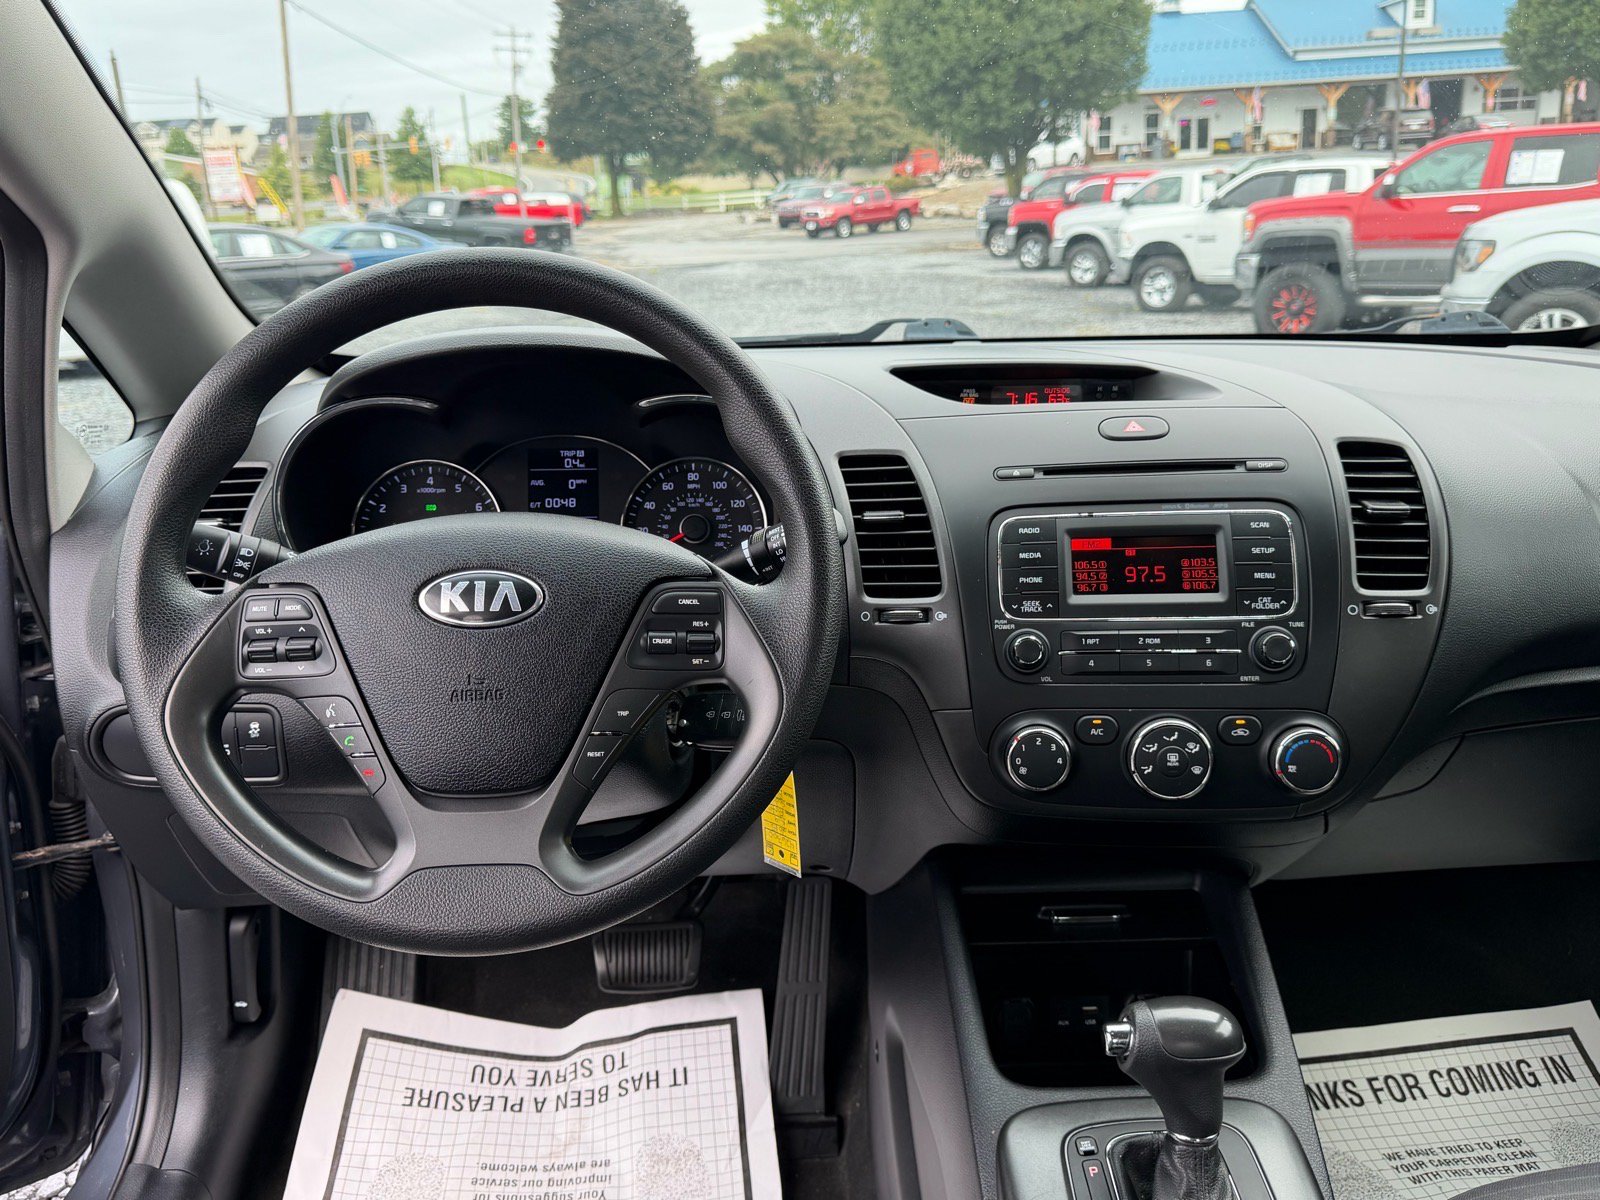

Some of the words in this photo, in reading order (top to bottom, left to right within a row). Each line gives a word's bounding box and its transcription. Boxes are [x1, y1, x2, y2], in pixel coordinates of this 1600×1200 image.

[1006, 392, 1038, 405] 7:16
[426, 476, 434, 485] 4
[687, 472, 700, 481] 80
[400, 484, 407, 494] 3
[455, 483, 462, 493] 5
[662, 482, 674, 491] 60
[712, 481, 728, 490] 100
[379, 504, 387, 513] 2
[475, 503, 483, 512] 6
[643, 501, 656, 510] 40
[730, 499, 745, 508] 120
[737, 524, 753, 533] 140
[770, 533, 780, 541] OFF
[775, 548, 784, 556] LO
[1074, 561, 1098, 569] 106.5
[1190, 558, 1215, 566] 103.5
[1075, 572, 1097, 580] 94.5
[1125, 565, 1166, 583] 97.5
[1191, 570, 1216, 578] 105.5
[1191, 581, 1216, 589] 106.7
[440, 580, 522, 613] KIA
[1206, 659, 1212, 667] 6
[450, 688, 504, 702] AIRBAG
[602, 1051, 629, 1074] TO
[471, 1064, 516, 1087] YOU
[525, 1058, 593, 1087] SERVE
[669, 1066, 688, 1088] IT
[618, 1070, 660, 1097] HAS
[1366, 1073, 1428, 1105] FOR
[1428, 1058, 1541, 1099] COMING
[1540, 1055, 1577, 1084] IN
[401, 1086, 524, 1113] PLEASURE
[555, 1085, 609, 1112] BEEN
[534, 1097, 547, 1113] A
[1383, 1151, 1405, 1162] WE
[1404, 1147, 1438, 1159] HAVE
[1437, 1143, 1475, 1156] TRIED
[1474, 1141, 1493, 1151] TO
[1494, 1138, 1524, 1150] KEEP
[542, 1160, 586, 1173] always
[591, 1159, 611, 1168] are
[1391, 1161, 1428, 1174] YOUR
[1428, 1154, 1496, 1168] CARPETING
[1496, 1150, 1538, 1162] CLEAN
[1089, 1166, 1098, 1177] P
[1408, 1170, 1442, 1185] WITH
[1442, 1167, 1473, 1178] THIS
[1474, 1164, 1514, 1176] PAPER
[1514, 1161, 1542, 1174] MAT
[471, 1177, 518, 1188] service
[522, 1179, 543, 1188] our
[547, 1174, 612, 1187] improving
[578, 1190, 607, 1200] Your
